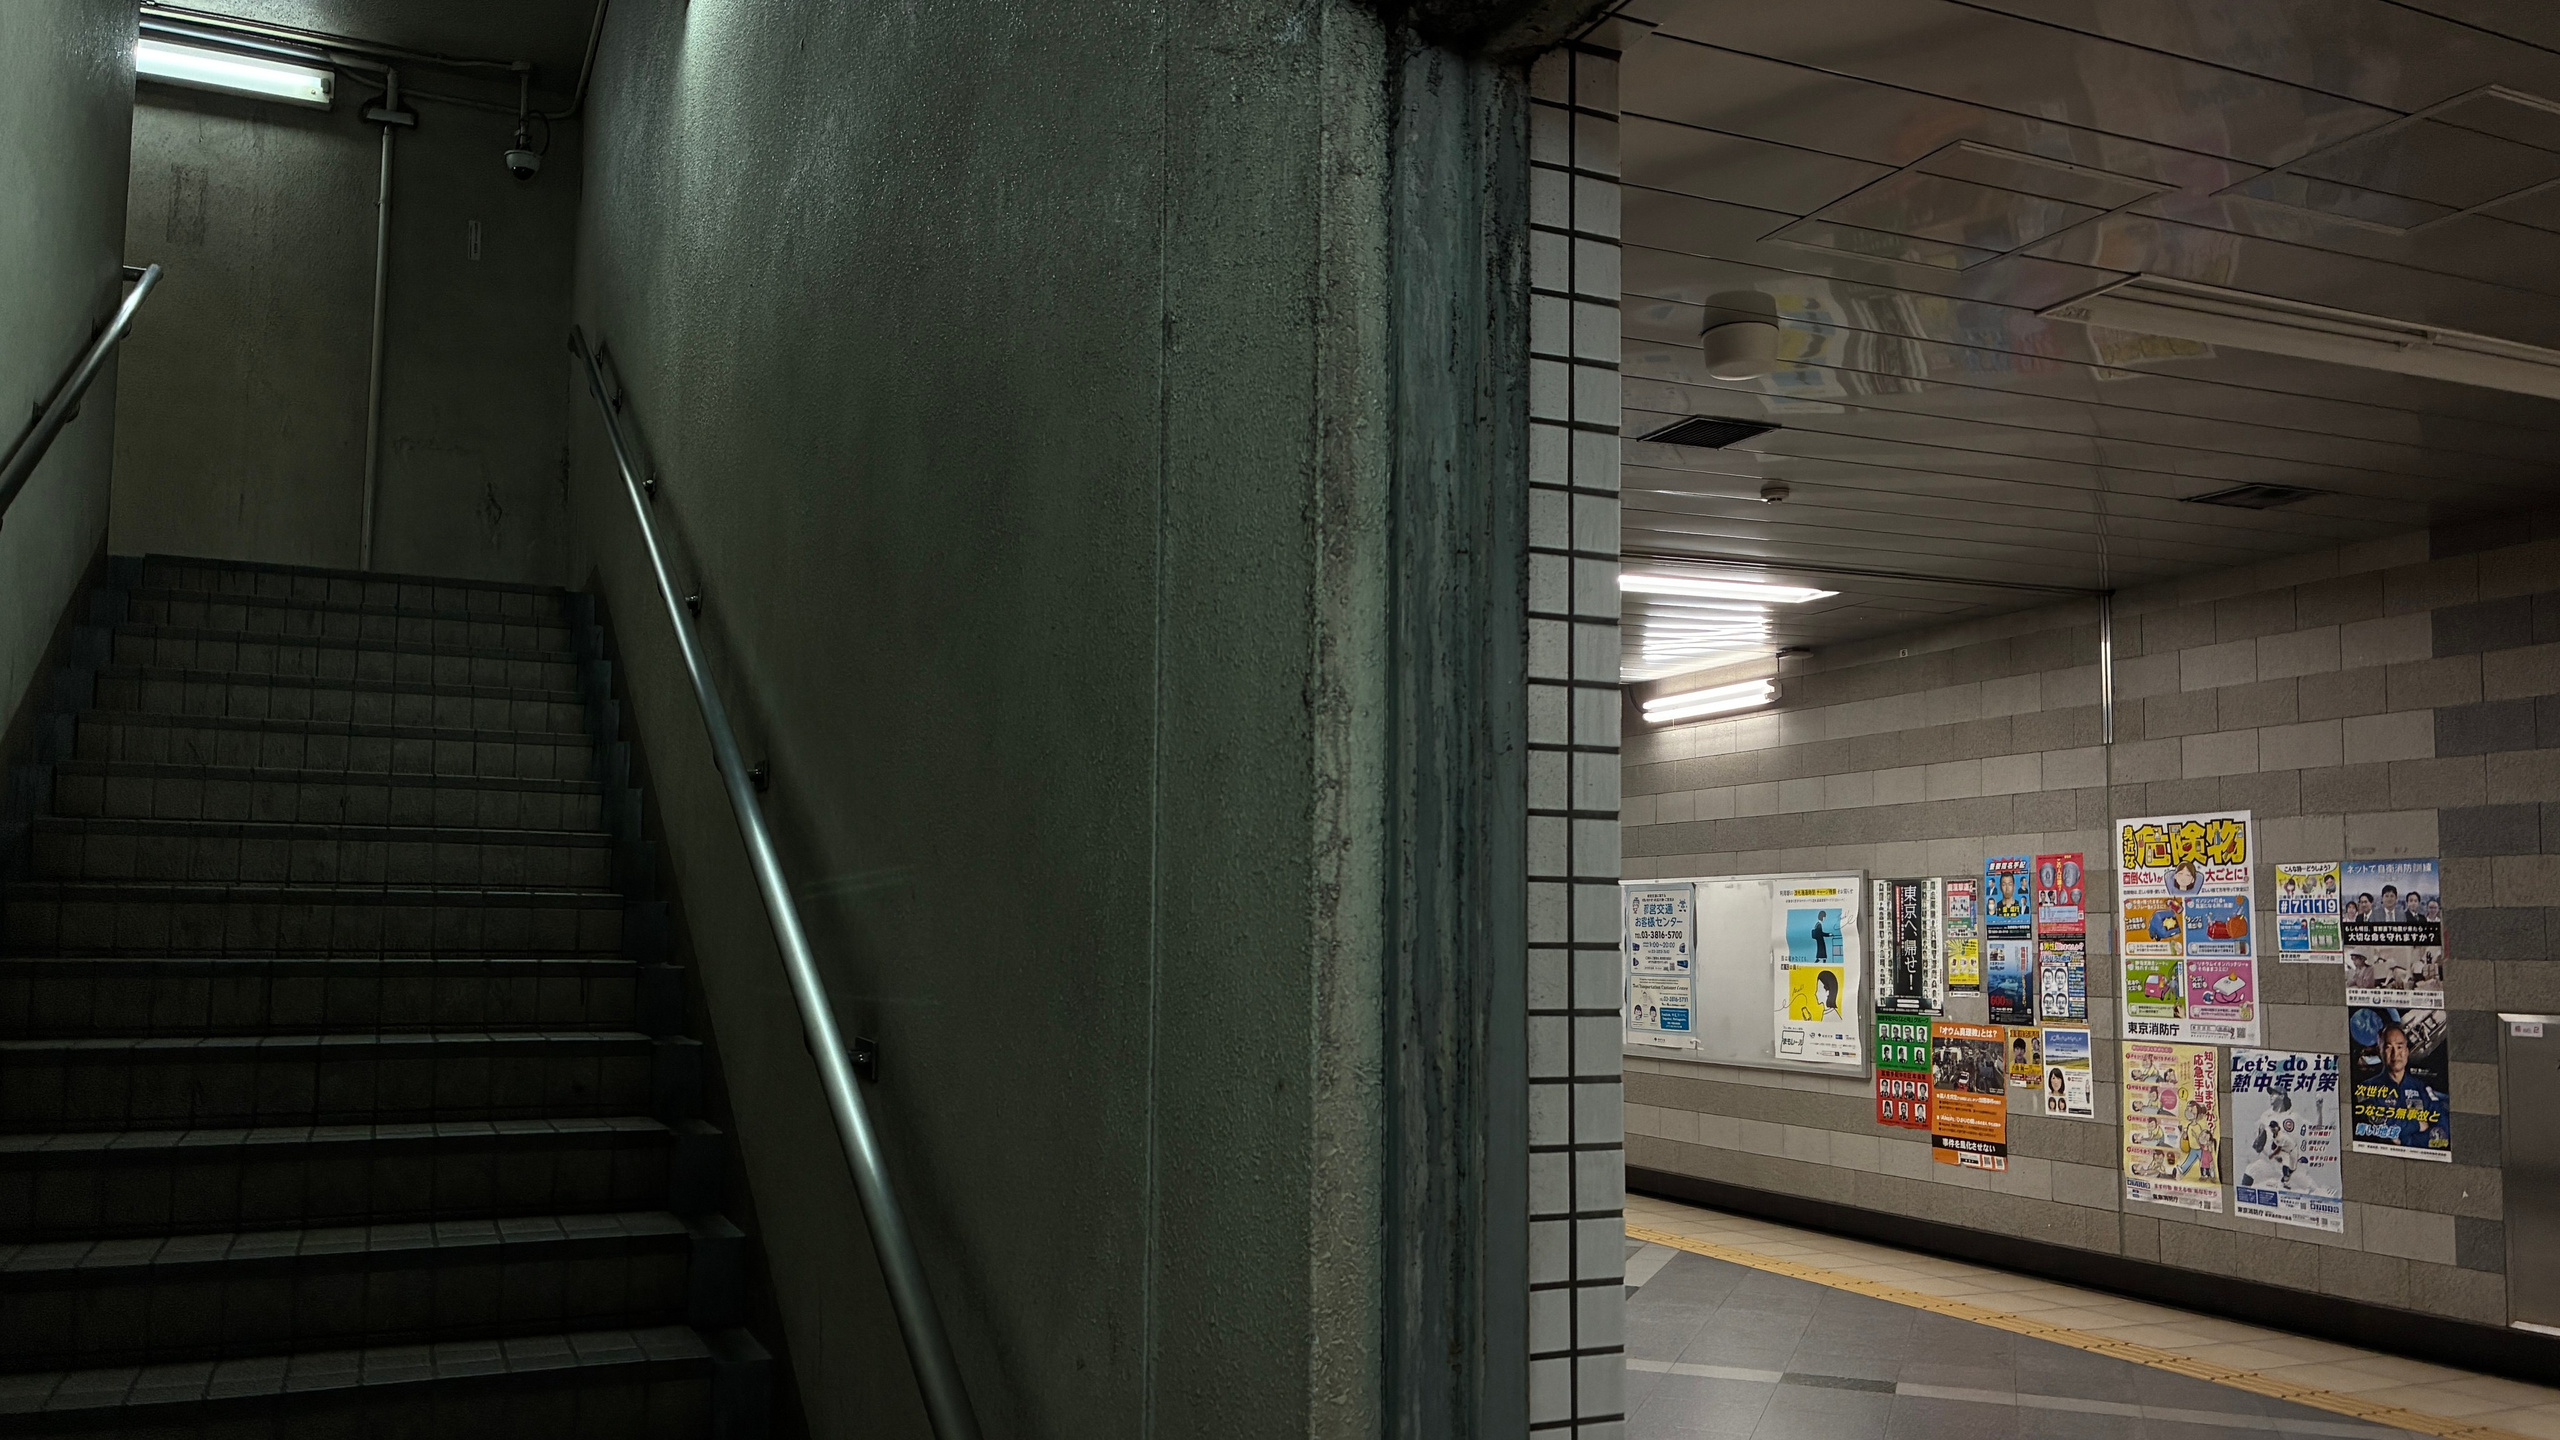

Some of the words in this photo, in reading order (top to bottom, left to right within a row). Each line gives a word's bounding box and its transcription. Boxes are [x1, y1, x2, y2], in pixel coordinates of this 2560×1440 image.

[2122, 825, 2136, 869] 身近な
[2134, 818, 2246, 867] 危険物
[2122, 871, 2164, 885] 面倒くさいが
[1643, 903, 1674, 915] 都営交通
[2279, 899, 2337, 913] #7119
[1635, 916, 1683, 928] お客様センター
[1641, 930, 1683, 939] 03-3816-5700
[1903, 885, 1919, 990] 東京へ、帰せ！
[2348, 932, 2435, 942] 大切な命を守れますか？
[1939, 1026, 1998, 1038] 「オウム真理教」とは？
[2127, 1021, 2180, 1036] 東京消防庁
[2231, 1055, 2278, 1072] Let's
[2283, 1054, 2309, 1071] do
[2313, 1054, 2339, 1071] it!
[2193, 1054, 2204, 1103] 応急手当
[2231, 1072, 2339, 1093] 熱中症対策
[2203, 1051, 2217, 1134] 知っていますか？
[2354, 1084, 2399, 1098] 次世代へ
[2355, 1122, 2402, 1139] 青い地球
[1942, 1138, 1996, 1153] 事件を風化させない
